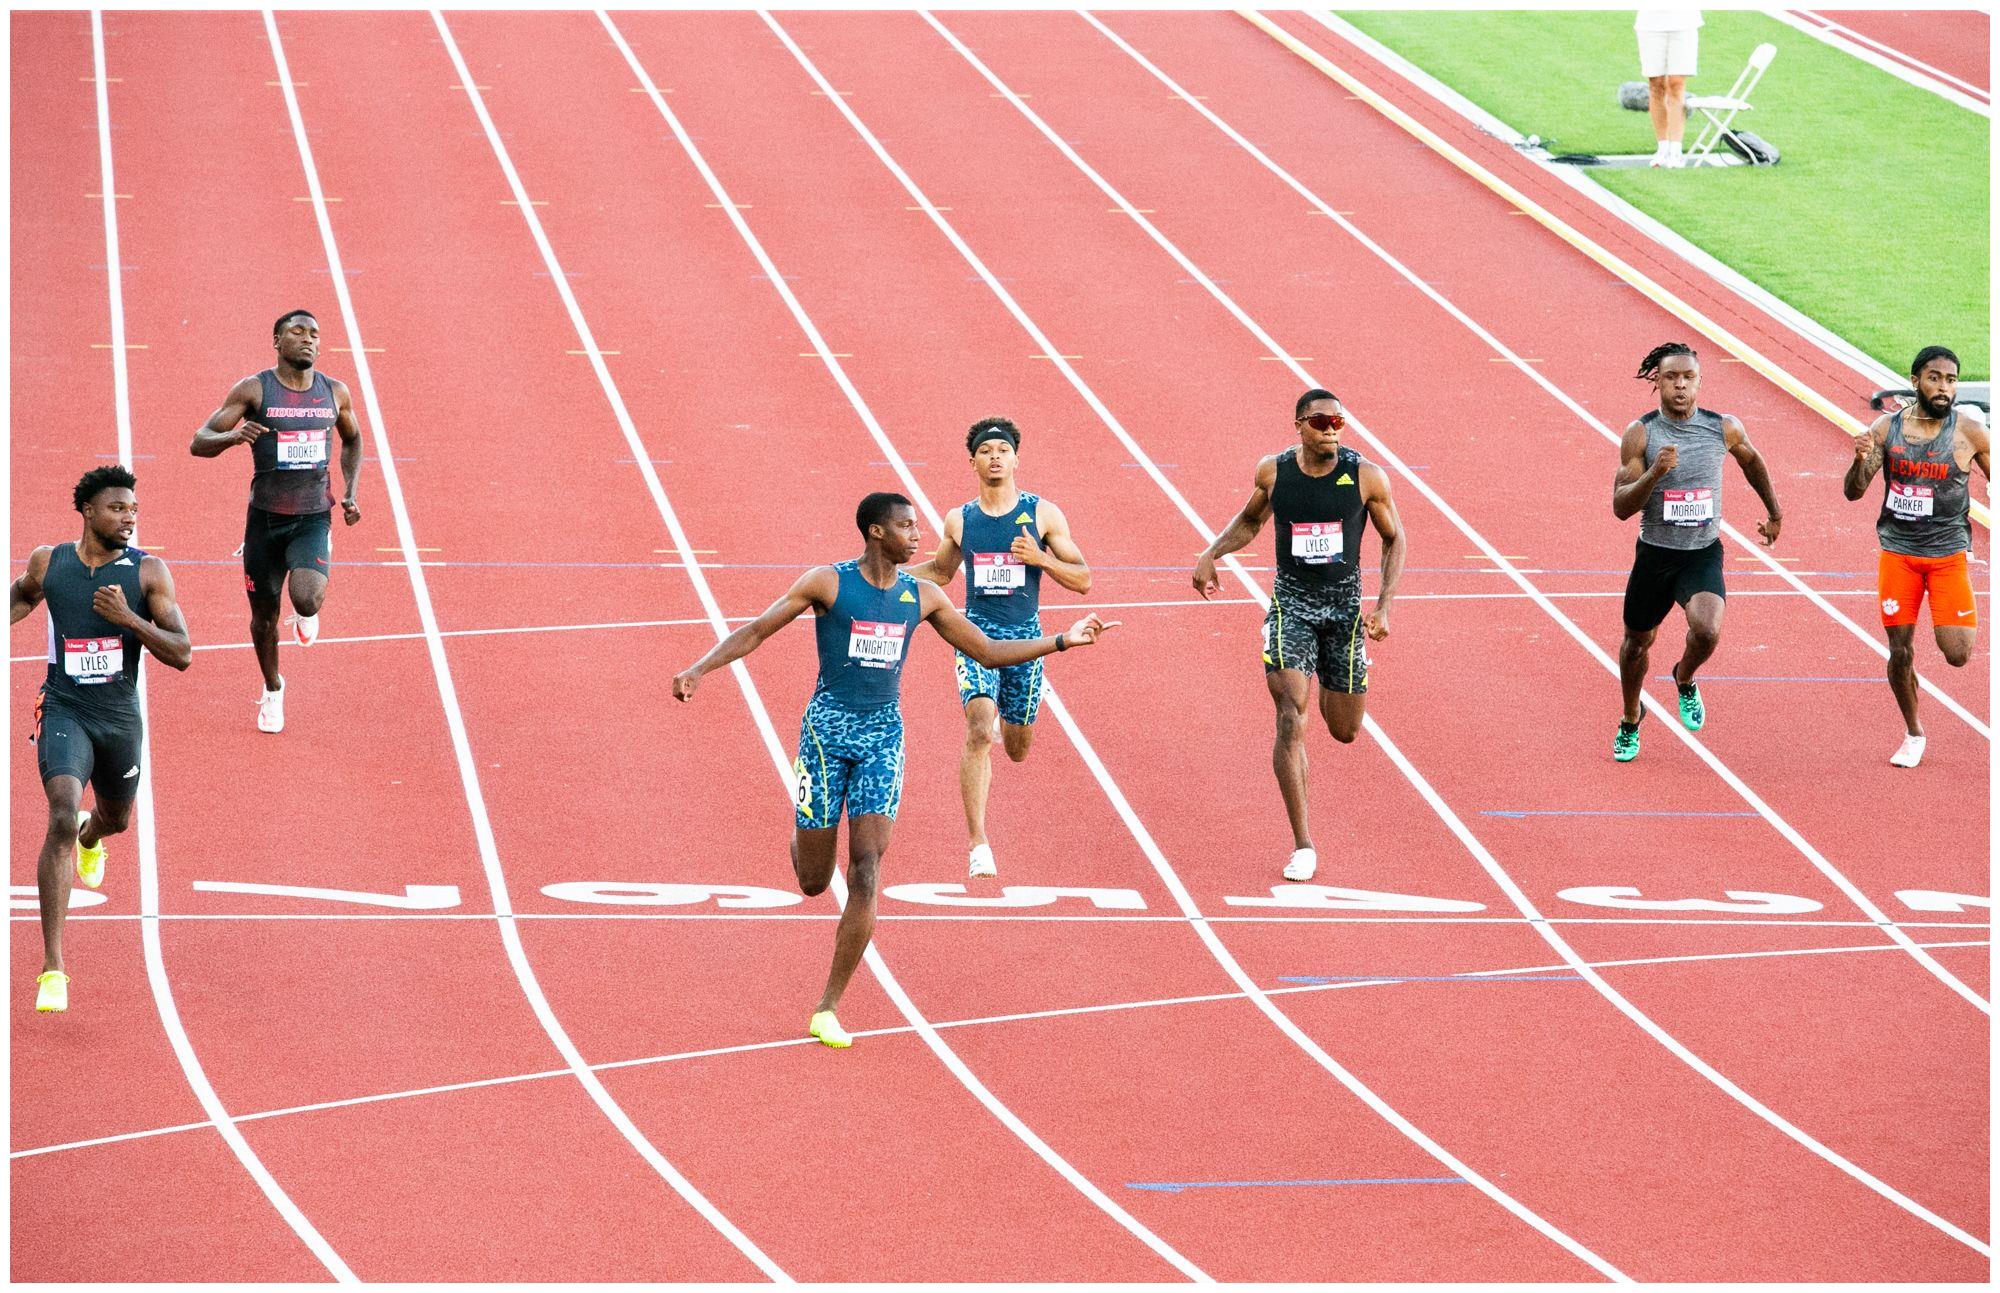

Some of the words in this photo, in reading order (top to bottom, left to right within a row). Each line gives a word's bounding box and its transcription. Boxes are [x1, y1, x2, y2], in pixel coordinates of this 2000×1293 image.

[266, 407, 335, 419] HOUSTON
[287, 445, 318, 459] BOOKER
[1889, 457, 1950, 480] LEMSON
[1671, 504, 1707, 517] MORROW
[1893, 496, 1923, 512] PARKER
[1305, 538, 1330, 552] LYLES
[987, 569, 1011, 583] LAIRD
[855, 638, 899, 656] KNIGHTON
[80, 655, 108, 671] LYLES
[798, 775, 807, 803] 6
[193, 881, 461, 909] 7
[540, 881, 804, 909] 6
[882, 882, 1148, 910] 5
[1223, 883, 1487, 913] 4
[1556, 886, 1824, 915] 3
